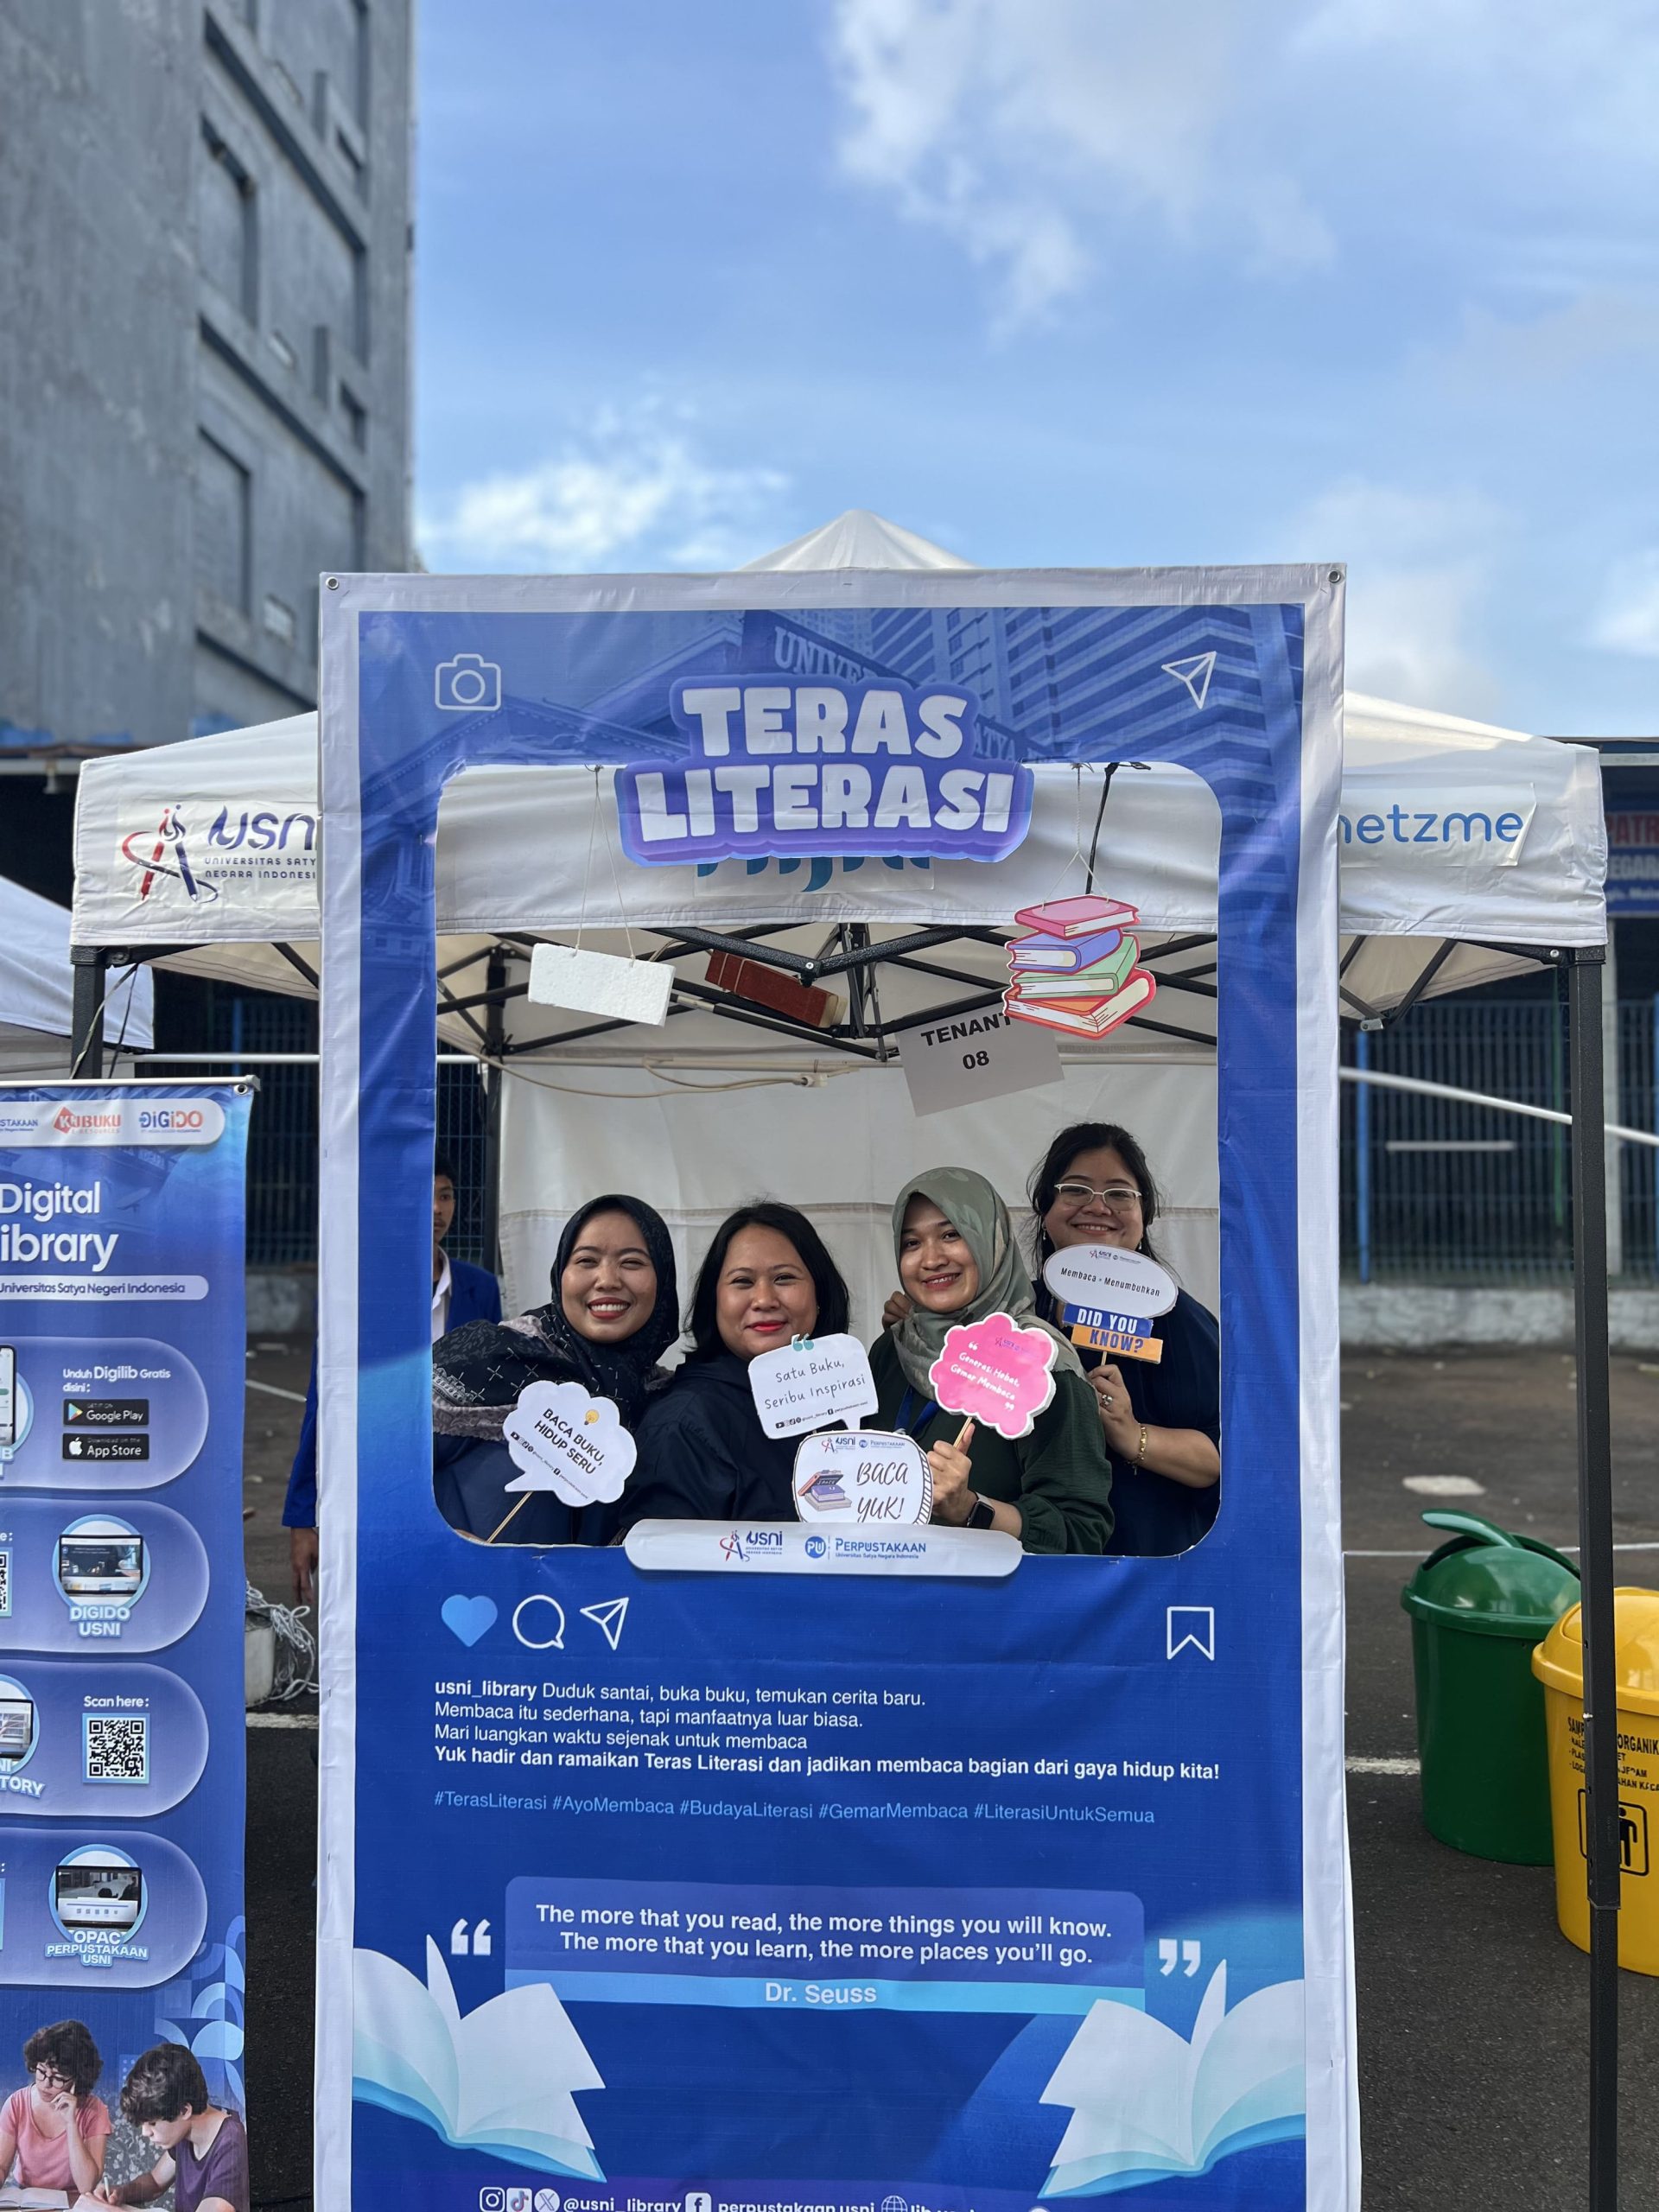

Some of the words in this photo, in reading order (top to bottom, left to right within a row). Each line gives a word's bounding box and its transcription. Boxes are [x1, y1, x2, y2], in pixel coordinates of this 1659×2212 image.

[683, 687, 967, 758] TERAS
[635, 764, 1014, 842] LITERASI
[1338, 804, 1524, 844] netzme
[921, 1013, 1011, 1046] TENANT
[963, 1050, 990, 1070] 08
[0, 1118, 39, 1127] STAKAAN
[0, 1181, 100, 1222] Digital
[1, 1224, 118, 1272] ibrary
[58, 1283, 86, 1296] Satya
[87, 1283, 125, 1296] Negeri
[128, 1282, 186, 1293] Indonesia
[1060, 1267, 1096, 1282] Membaca
[1104, 1277, 1160, 1296] Menumbuhkan
[1077, 1307, 1103, 1327] DID
[1109, 1314, 1138, 1334] YOU
[1090, 1329, 1144, 1353] KNOW?
[63, 1368, 92, 1378] Unduh
[94, 1365, 138, 1382] Digilib
[140, 1369, 171, 1378] Gratis
[775, 1367, 806, 1383] Satu
[810, 1357, 845, 1376] Buku,
[959, 1352, 993, 1374] Generasi
[764, 1389, 804, 1410] Seribu
[810, 1373, 866, 1399] Inspirasi
[950, 1363, 976, 1381] Gemar
[977, 1376, 1015, 1401] Membaca
[86, 1410, 122, 1423] Google
[123, 1410, 144, 1421] Play
[534, 1420, 567, 1450] HIDUP
[567, 1447, 596, 1475] SERU
[543, 1408, 574, 1438] BACA
[573, 1433, 605, 1466] BUKU,
[86, 1446, 110, 1459] App
[112, 1445, 143, 1456] Store
[70, 1606, 130, 1621] DIGIDO
[79, 1622, 121, 1637] USNI
[84, 1696, 114, 1707] Scan
[435, 1681, 537, 1700] usni_library
[543, 1683, 594, 1698] Duduk
[601, 1686, 653, 1701] santai,
[660, 1686, 700, 1700] buka
[706, 1687, 749, 1704] buku,
[756, 1688, 826, 1703] temukan
[833, 1691, 877, 1704] cerita
[884, 1690, 925, 1705] baru.
[435, 1701, 513, 1719] Membaca
[519, 1707, 537, 1719] itu
[543, 1707, 633, 1724] sederhana,
[640, 1709, 669, 1726] tapi
[676, 1709, 772, 1729] manfaatnya
[779, 1711, 808, 1726] luar
[814, 1712, 862, 1726] biasa.
[435, 1724, 468, 1739] Mari
[475, 1726, 547, 1745] luangkan
[553, 1729, 601, 1744] waktu
[607, 1732, 669, 1748] sejenak
[676, 1732, 720, 1747] untuk
[727, 1734, 807, 1749] membaca
[1567, 1716, 1585, 1736] SAMP
[1617, 1733, 1659, 1755] ORGANIK
[435, 1746, 466, 1761] Yuk
[473, 1748, 515, 1764] hadir
[521, 1750, 552, 1764] dan
[559, 1752, 638, 1767] ramaikan
[645, 1753, 691, 1769] Teras
[698, 1755, 762, 1771] Literasi
[769, 1757, 801, 1772] dan
[807, 1757, 870, 1776] jadikan
[877, 1758, 963, 1772] membaca
[969, 1758, 1028, 1777] bagian
[1034, 1759, 1068, 1774] dari
[1075, 1764, 1116, 1779] gaya
[1124, 1761, 1174, 1781] hidup
[1181, 1763, 1218, 1778] kita!
[1571, 1747, 1585, 1761] PLAS
[435, 1791, 546, 1809] #TerasLiterasi
[553, 1796, 674, 1814] #AyoMembaca
[681, 1800, 812, 1819] #BudayaLiterasi
[819, 1803, 968, 1818] #GemarMembaca
[975, 1804, 1154, 1822] #LiterasiUntukSemua
[537, 1904, 574, 1923] The
[582, 1910, 633, 1924] more
[640, 1909, 679, 1927] that
[686, 1914, 723, 1932] you
[732, 1913, 782, 1934] read,
[789, 1914, 822, 1930] the
[830, 1917, 882, 1932] more
[889, 1916, 954, 1937] things
[962, 1920, 1000, 1937] you
[1007, 1916, 1041, 1933] will
[1051, 1917, 1110, 1936] know.
[73, 1930, 121, 1945] OPAC
[561, 1932, 598, 1949] The
[606, 1937, 658, 1952] more
[664, 1936, 703, 1955] that
[710, 1942, 747, 1960] you
[756, 1940, 813, 1961] learn,
[820, 1940, 853, 1957] the
[861, 1945, 913, 1959] more
[921, 1942, 988, 1964] places
[995, 1943, 1052, 1964] you'll
[1060, 1948, 1091, 1967] go.
[47, 1945, 147, 1958] PERPUSTAKAAN
[83, 1955, 111, 1965] USNI
[766, 1983, 796, 2001] Dr.
[805, 1985, 876, 2004] Seuss
